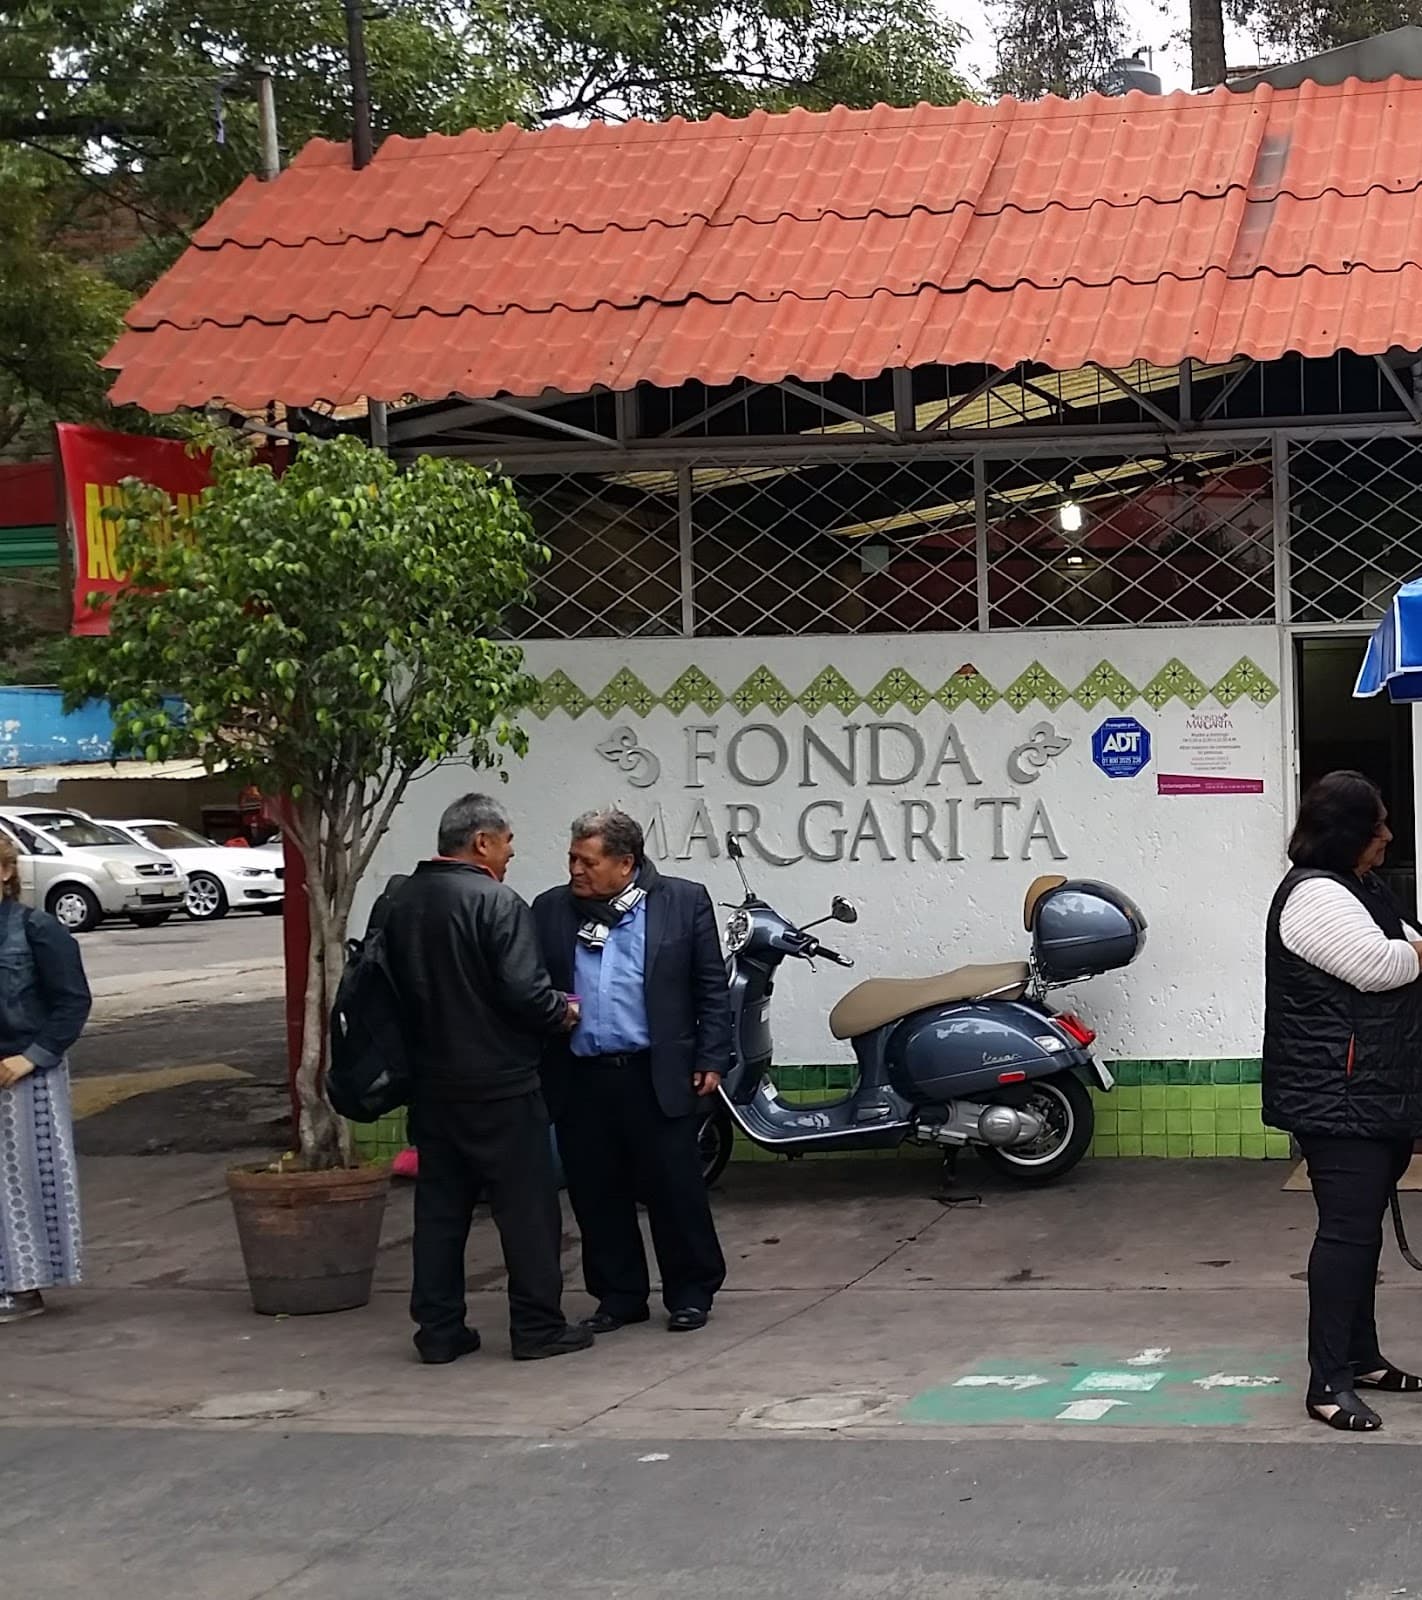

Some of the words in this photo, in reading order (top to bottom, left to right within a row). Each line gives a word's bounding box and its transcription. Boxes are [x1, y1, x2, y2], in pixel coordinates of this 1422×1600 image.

[1186, 720, 1233, 729] MARGARITA
[1102, 732, 1141, 753] ADT
[683, 722, 983, 788] FONDA
